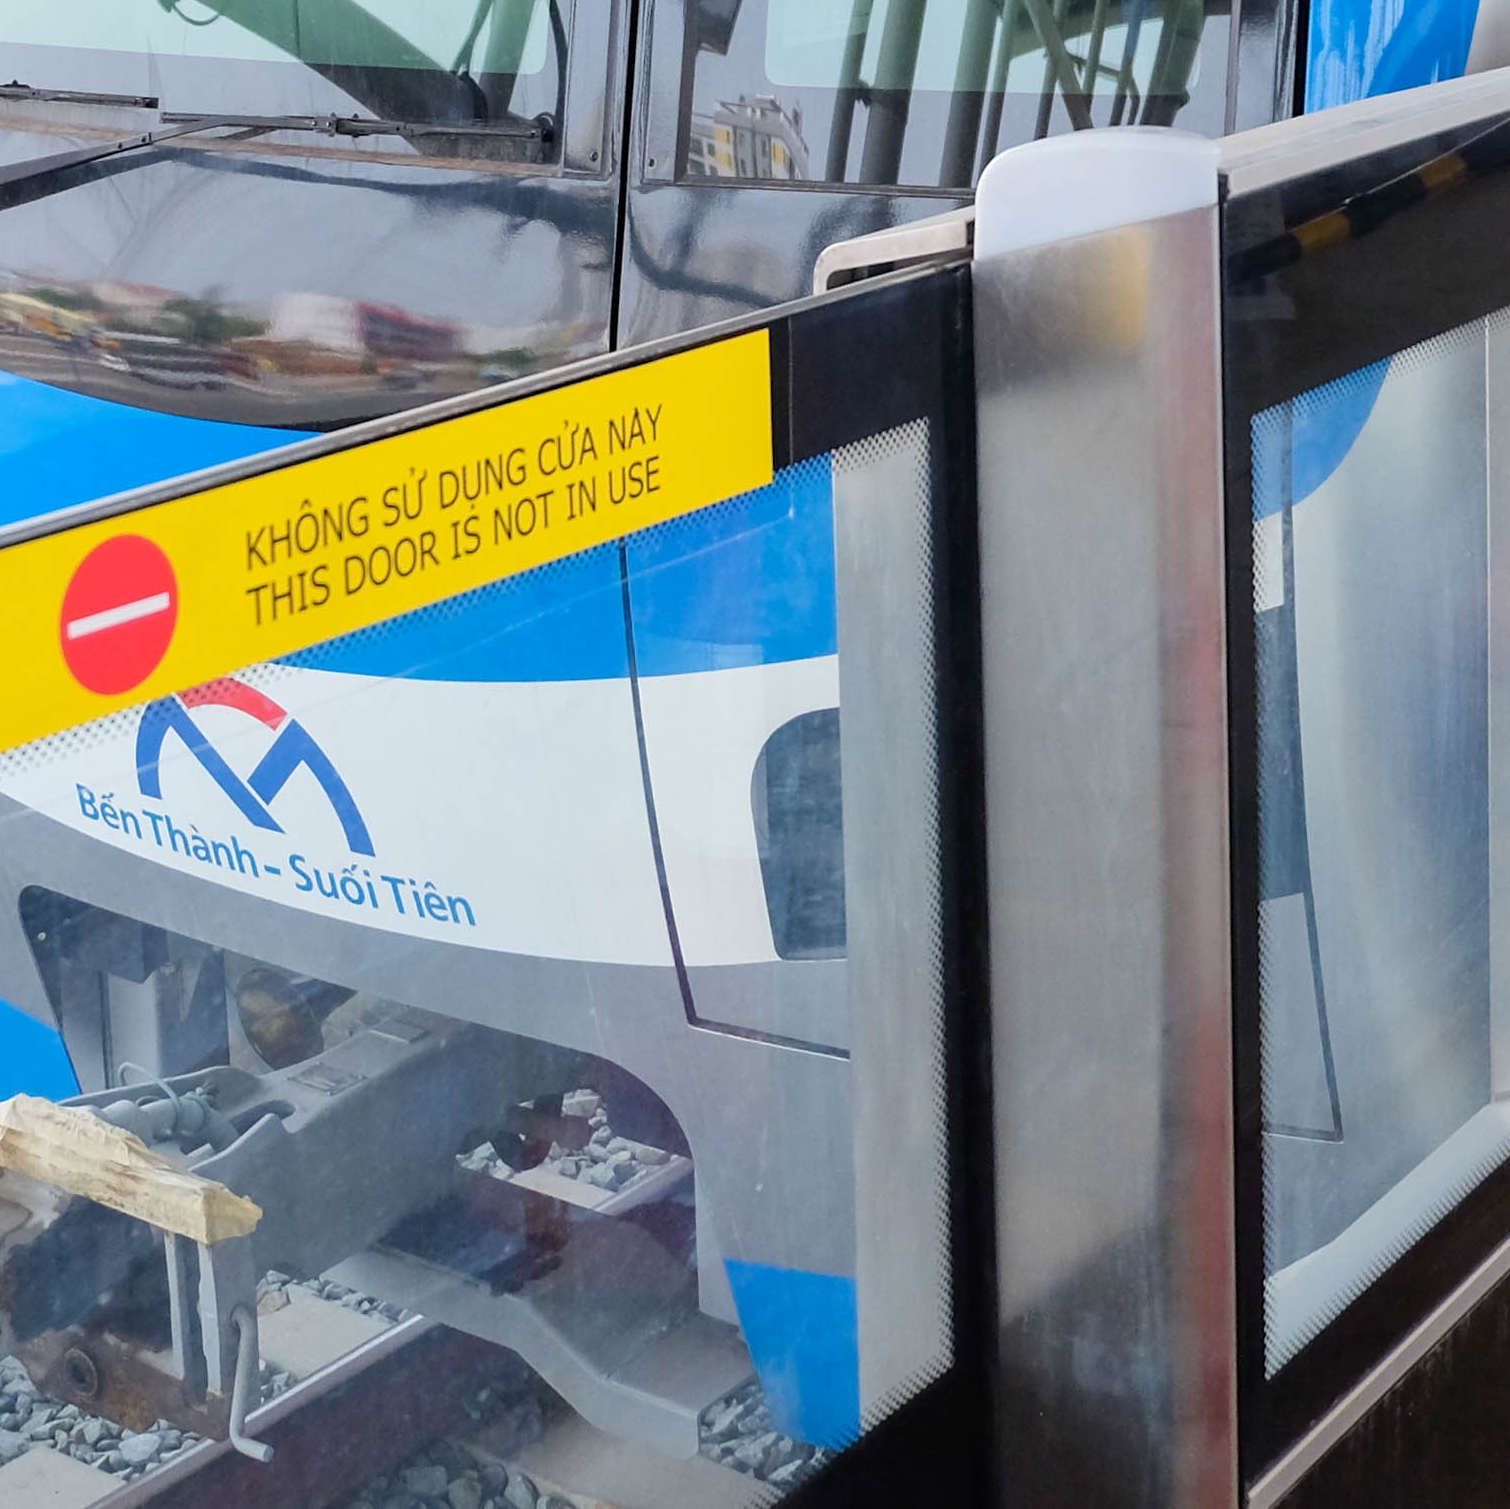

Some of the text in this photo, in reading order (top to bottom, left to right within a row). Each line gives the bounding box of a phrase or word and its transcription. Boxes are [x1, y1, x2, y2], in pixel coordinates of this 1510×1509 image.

[245, 456, 661, 627] THIS DOOR IS NOT IN USE
[246, 499, 370, 571] KHÔNG
[382, 466, 427, 527] SỬ
[439, 448, 527, 510] DỤNG
[537, 420, 598, 476] CỬA
[75, 783, 143, 838] Bến
[141, 809, 260, 878] Thành
[289, 854, 379, 909] Suối
[380, 874, 477, 926] Tiên
